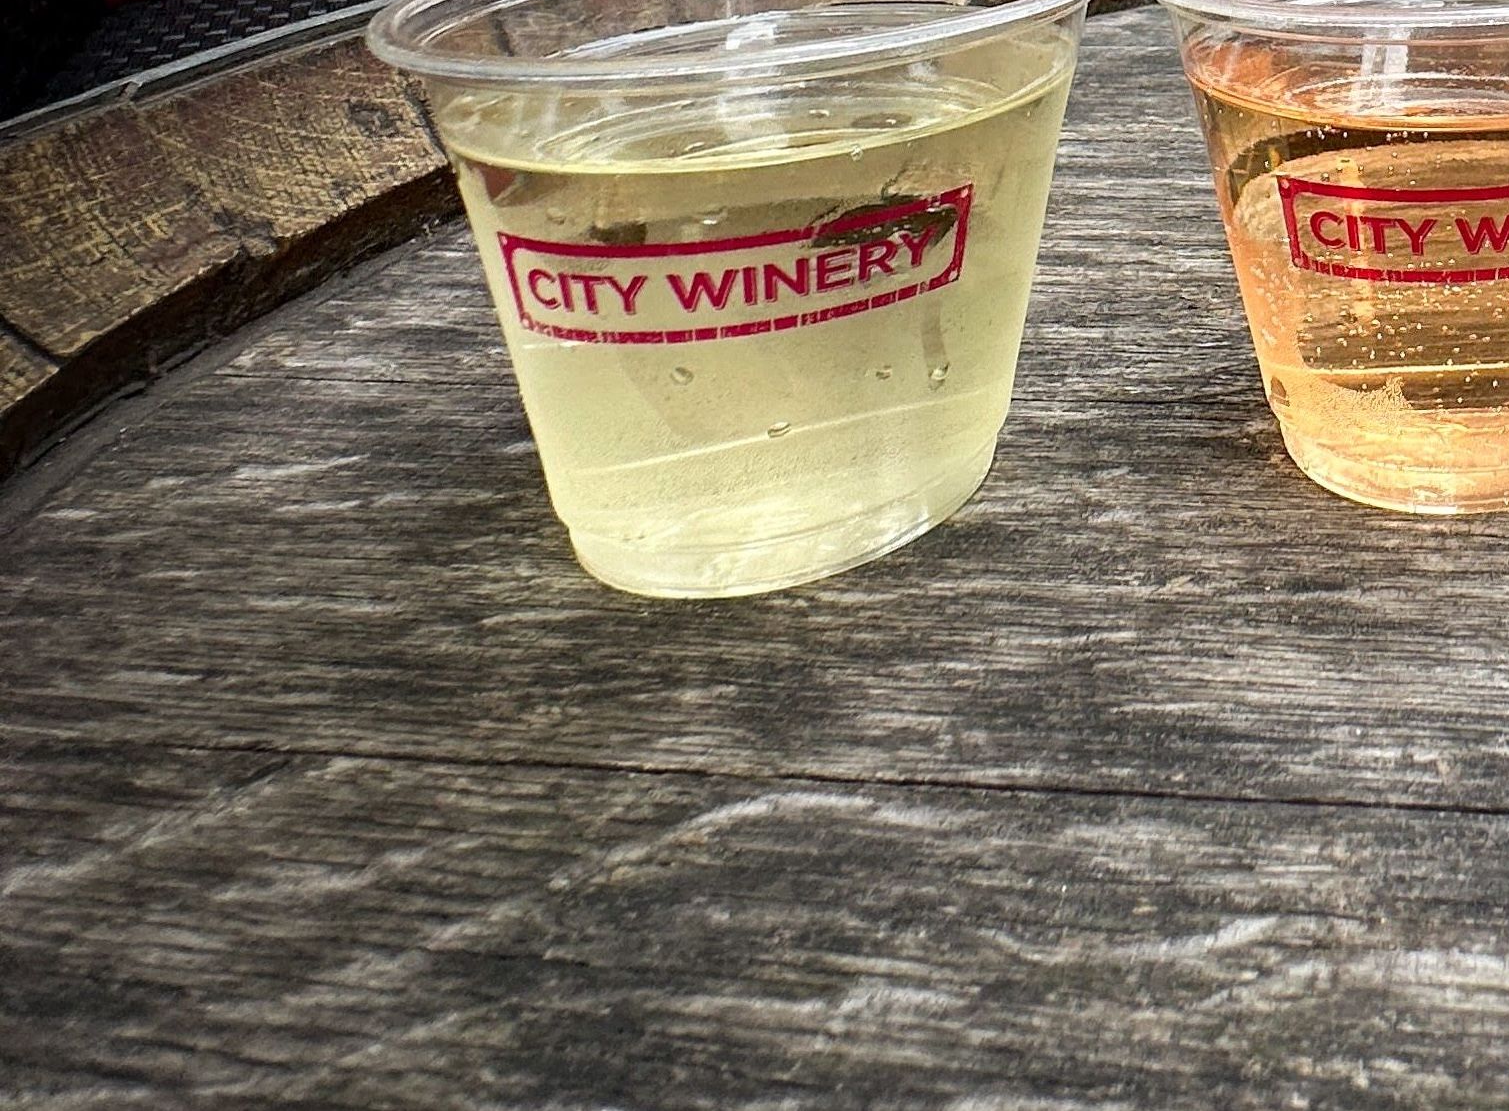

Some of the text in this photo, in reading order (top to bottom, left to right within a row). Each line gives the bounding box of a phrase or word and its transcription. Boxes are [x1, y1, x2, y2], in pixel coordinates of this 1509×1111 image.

[1310, 211, 1436, 256] CITY
[528, 227, 935, 315] CITY WINERY
